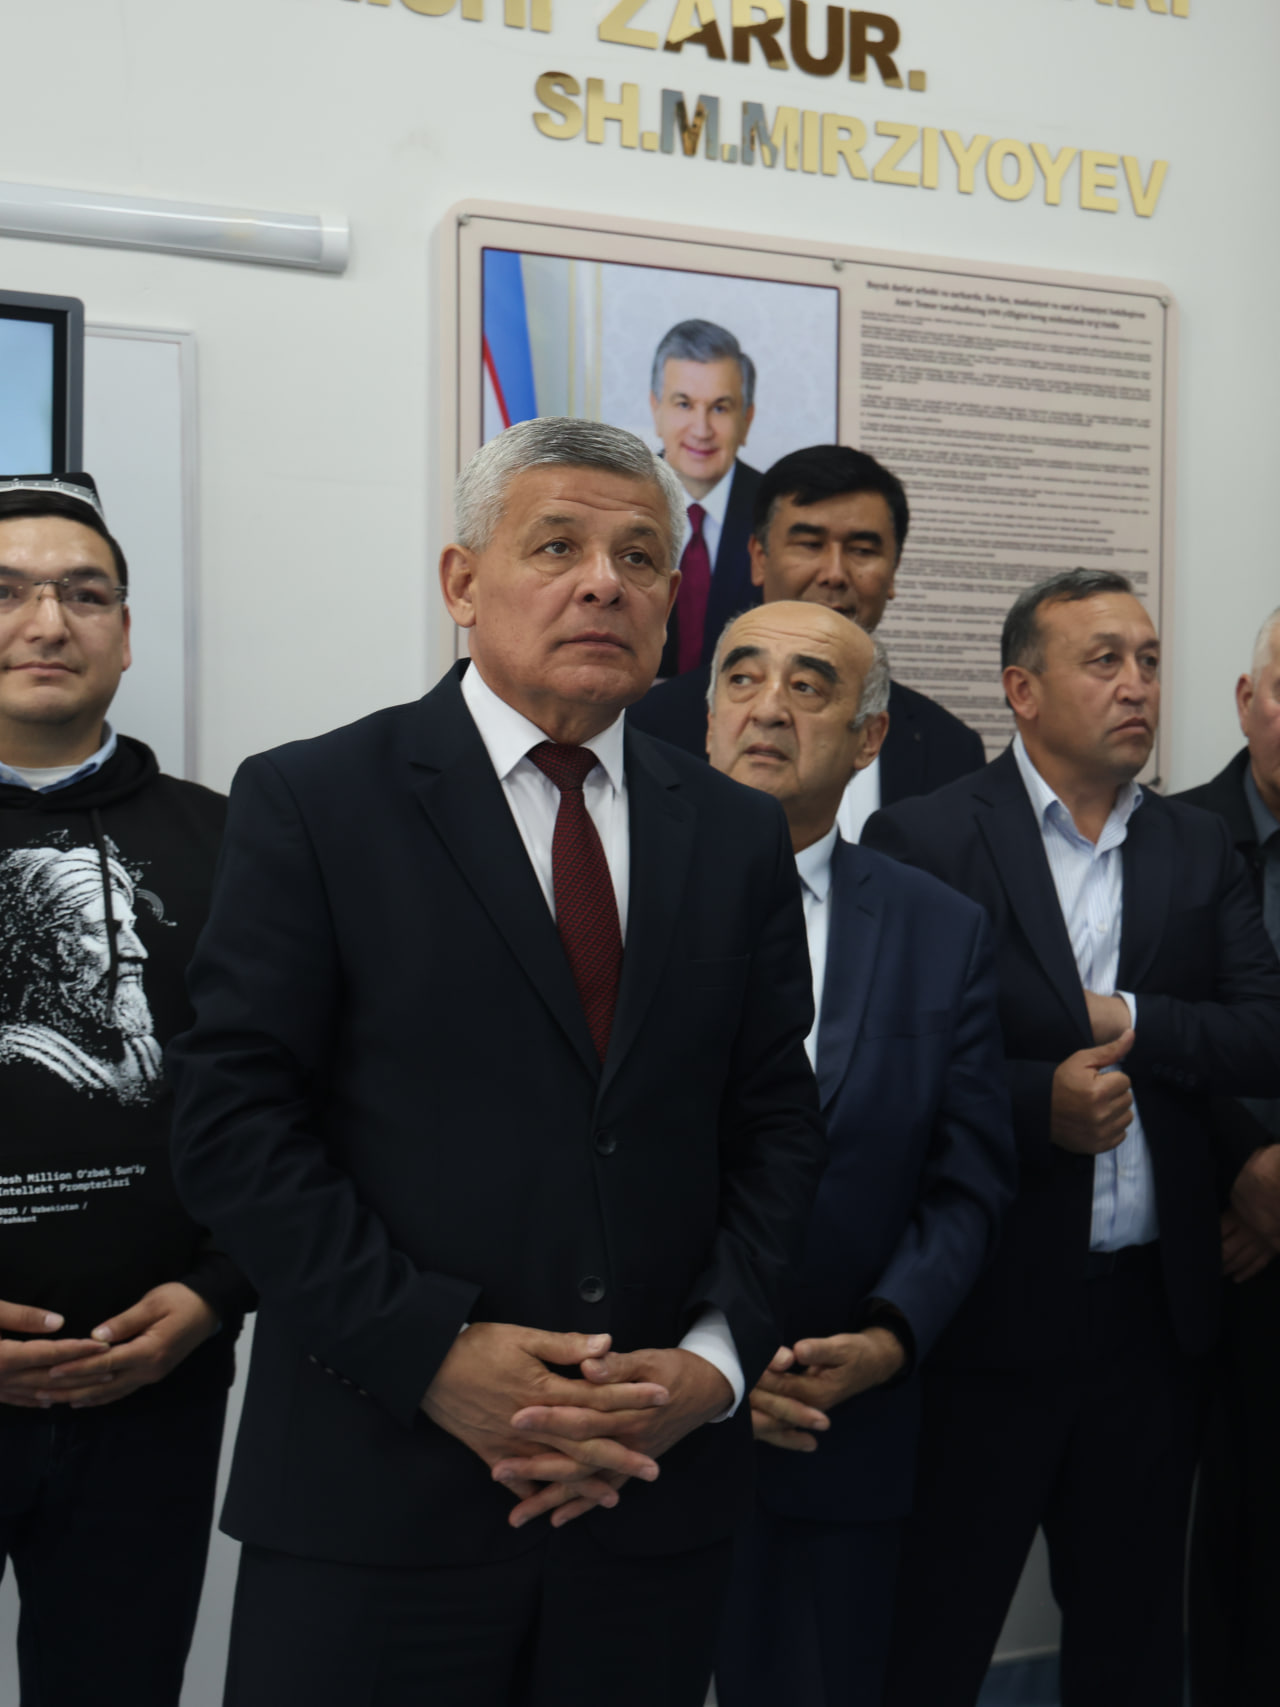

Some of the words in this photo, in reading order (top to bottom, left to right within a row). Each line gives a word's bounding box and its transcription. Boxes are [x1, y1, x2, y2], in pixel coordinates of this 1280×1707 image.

[597, 0, 927, 92] ZARUR.
[532, 70, 1169, 217] SH.M.MIRZIYOYEV
[27, 1172, 73, 1183] Million
